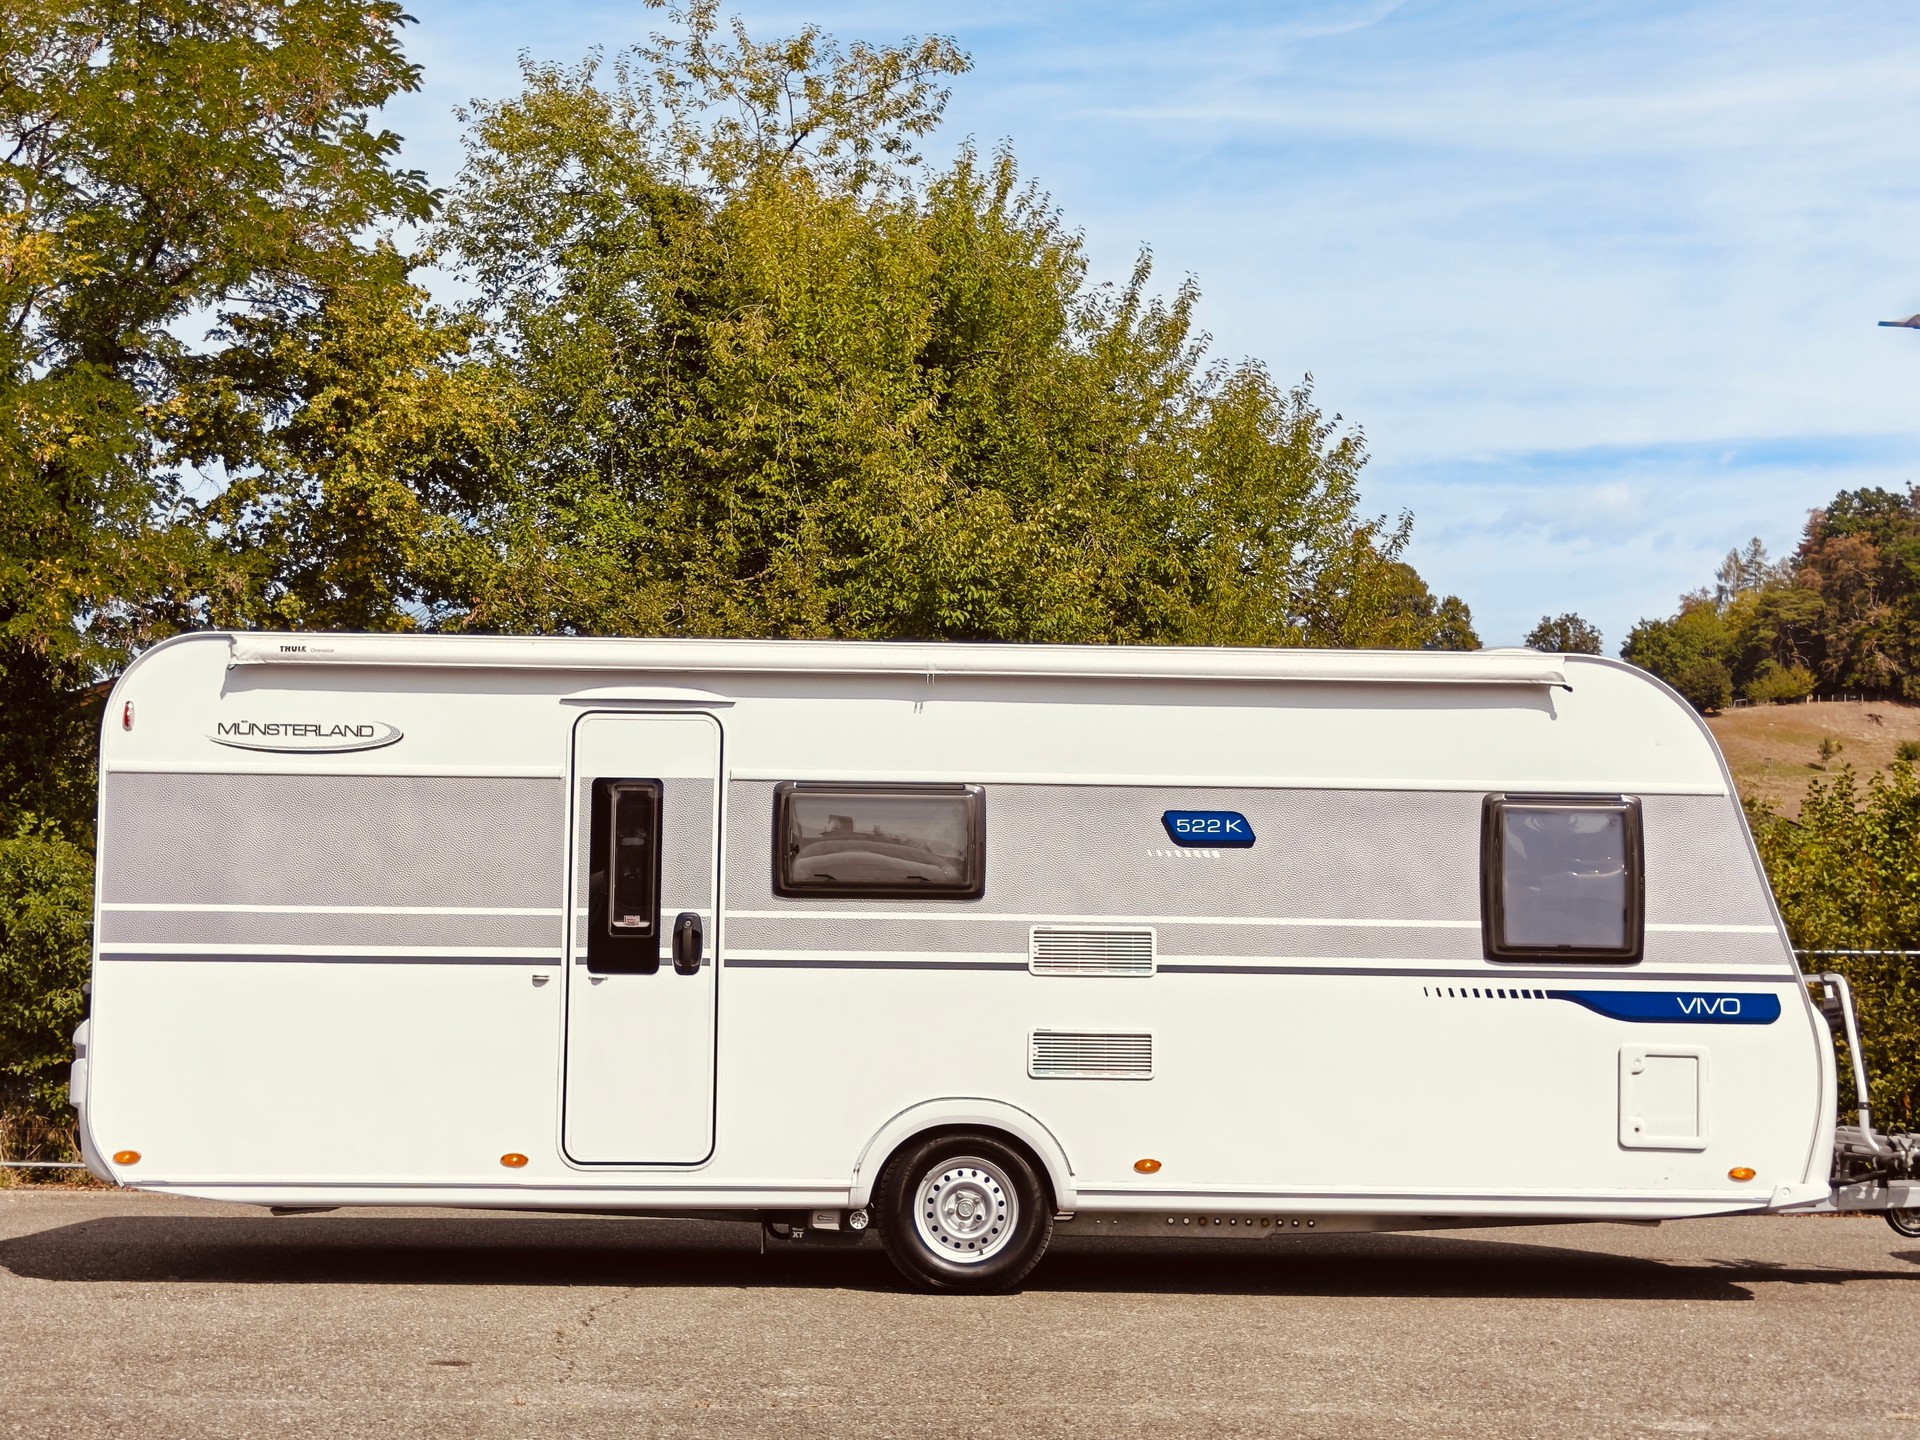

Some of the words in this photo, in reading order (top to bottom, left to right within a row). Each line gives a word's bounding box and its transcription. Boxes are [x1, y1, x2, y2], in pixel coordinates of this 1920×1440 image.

[279, 645, 307, 653] THULE
[217, 719, 375, 738] MÜNSTERLAND
[1176, 819, 1221, 833] 522
[1225, 819, 1242, 833] K
[1676, 997, 1741, 1015] VIVO
[792, 1231, 804, 1239] XT
